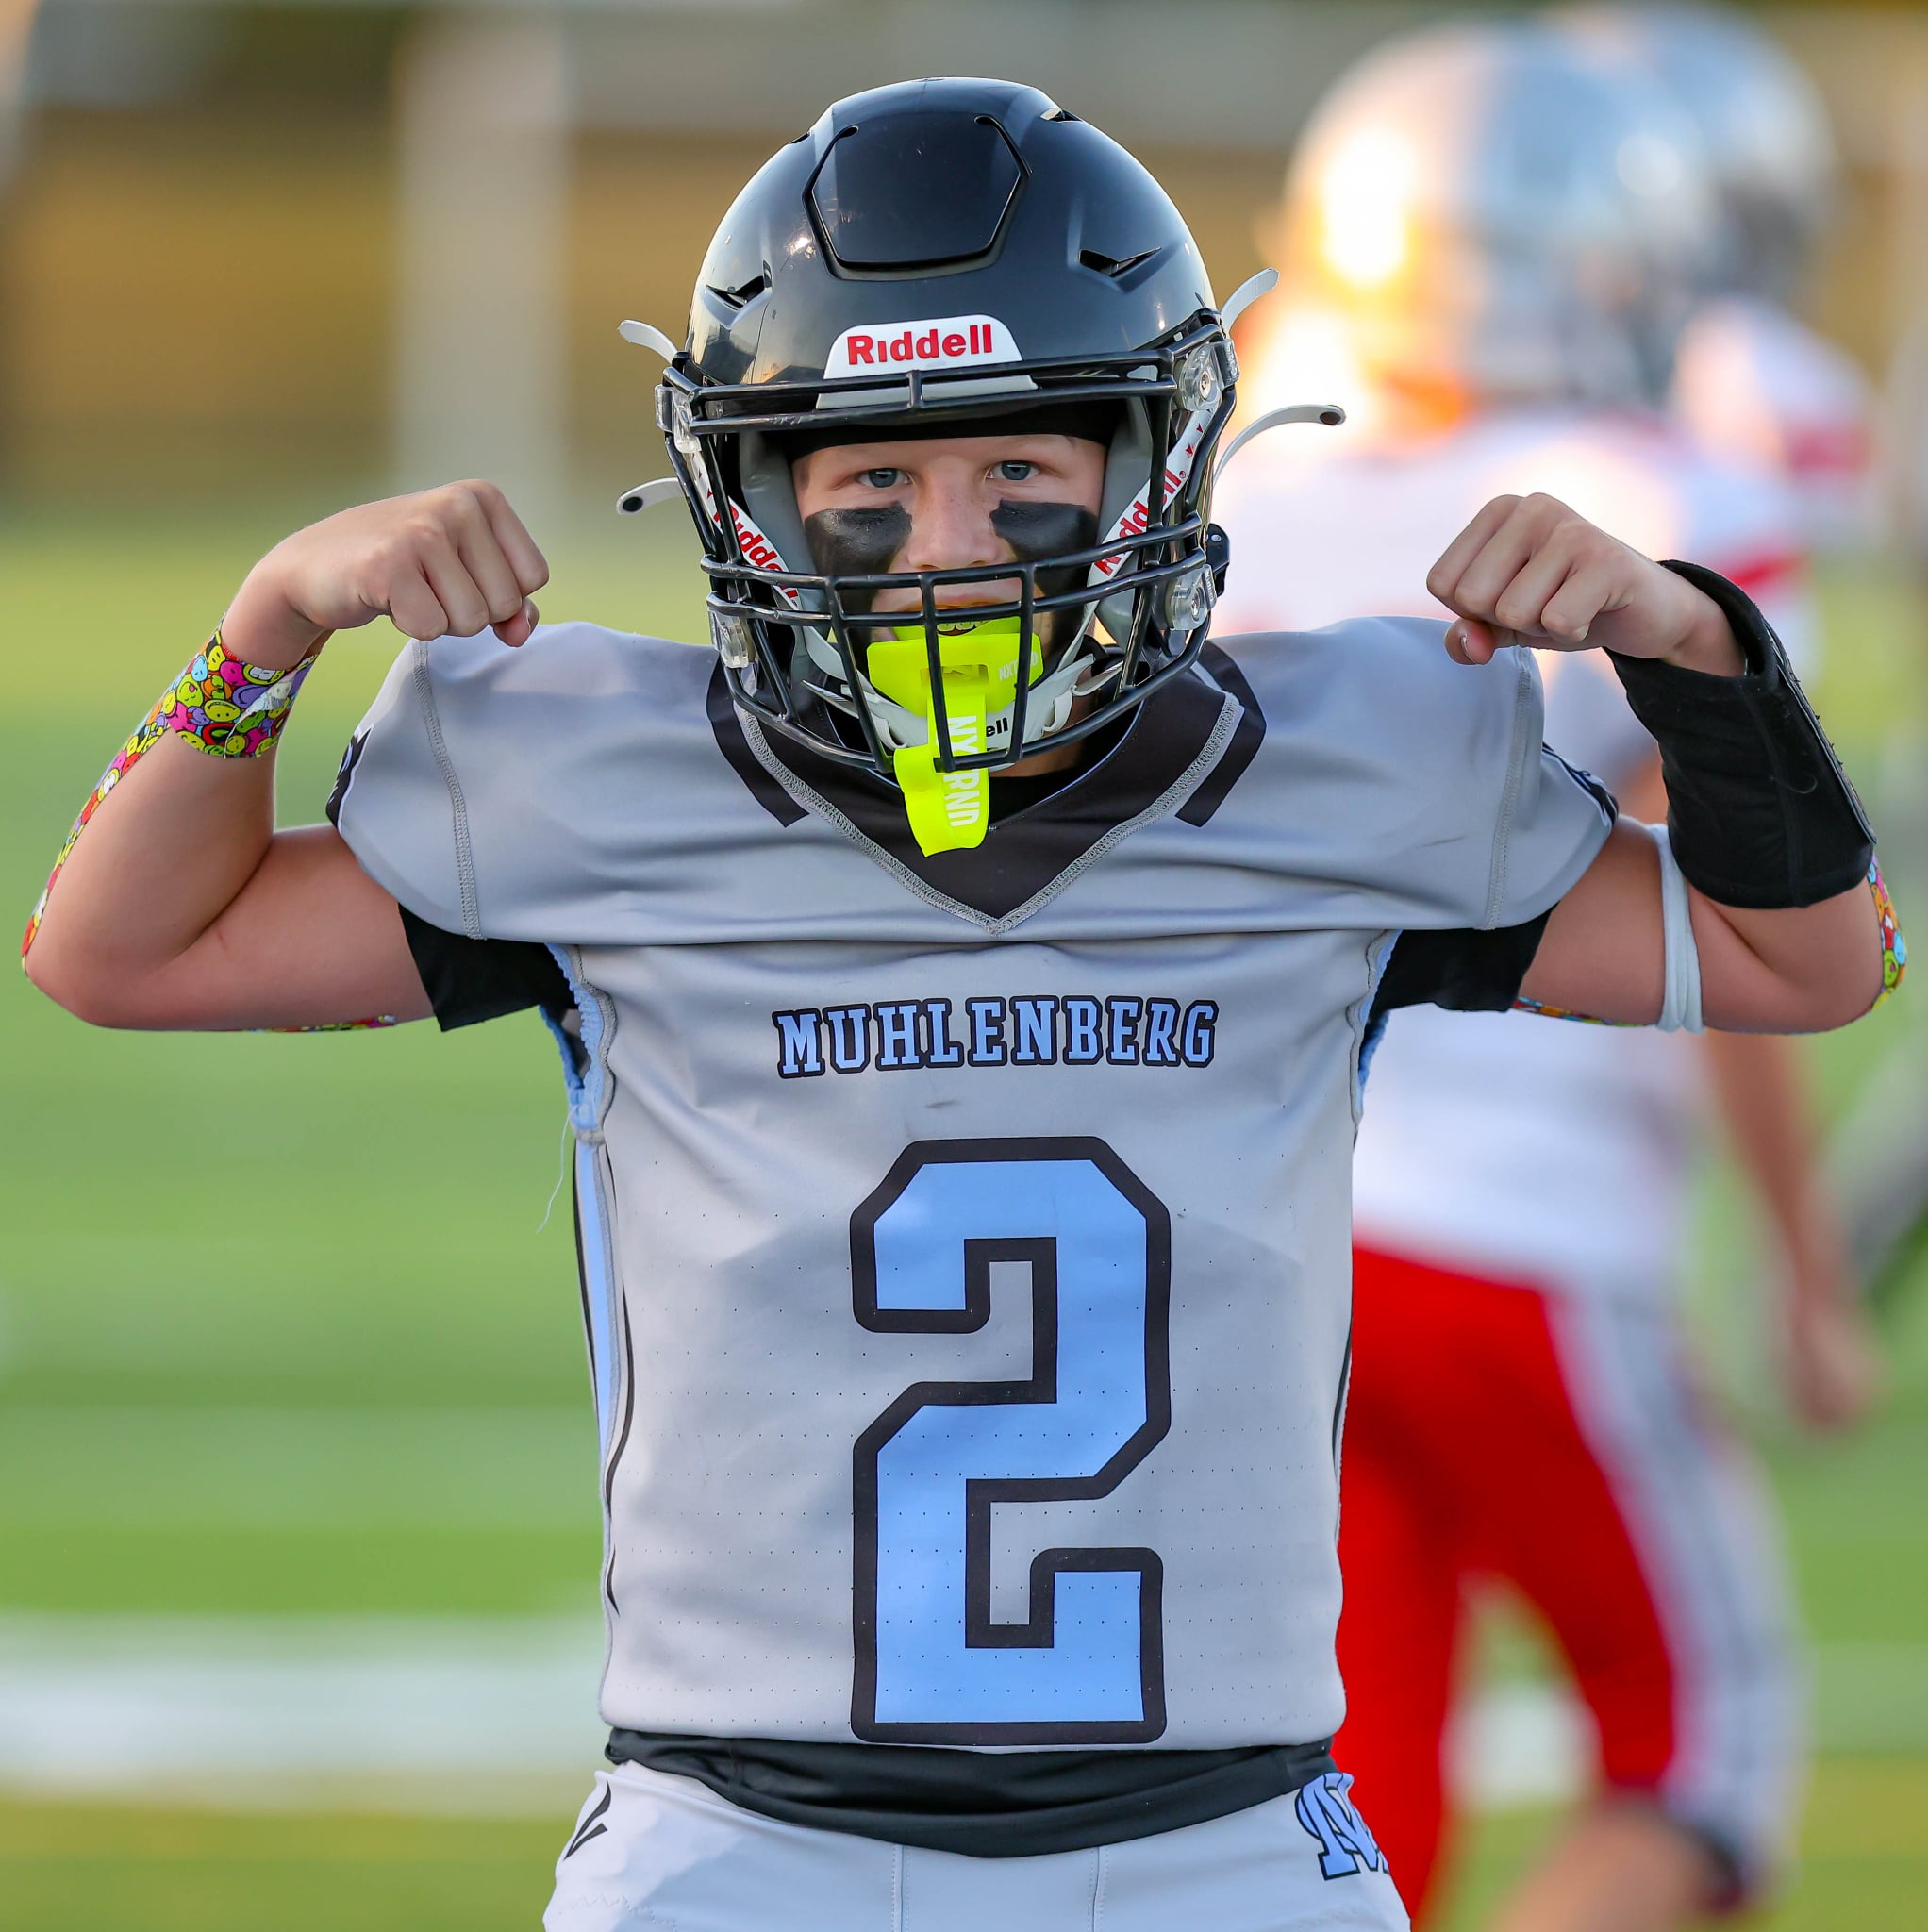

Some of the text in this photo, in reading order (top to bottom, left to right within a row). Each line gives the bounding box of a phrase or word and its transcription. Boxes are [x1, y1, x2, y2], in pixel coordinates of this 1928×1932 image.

[847, 324, 992, 365] Riddell
[772, 995, 1219, 1079] MUHLENBERG
[850, 1136, 1171, 1744] 2
